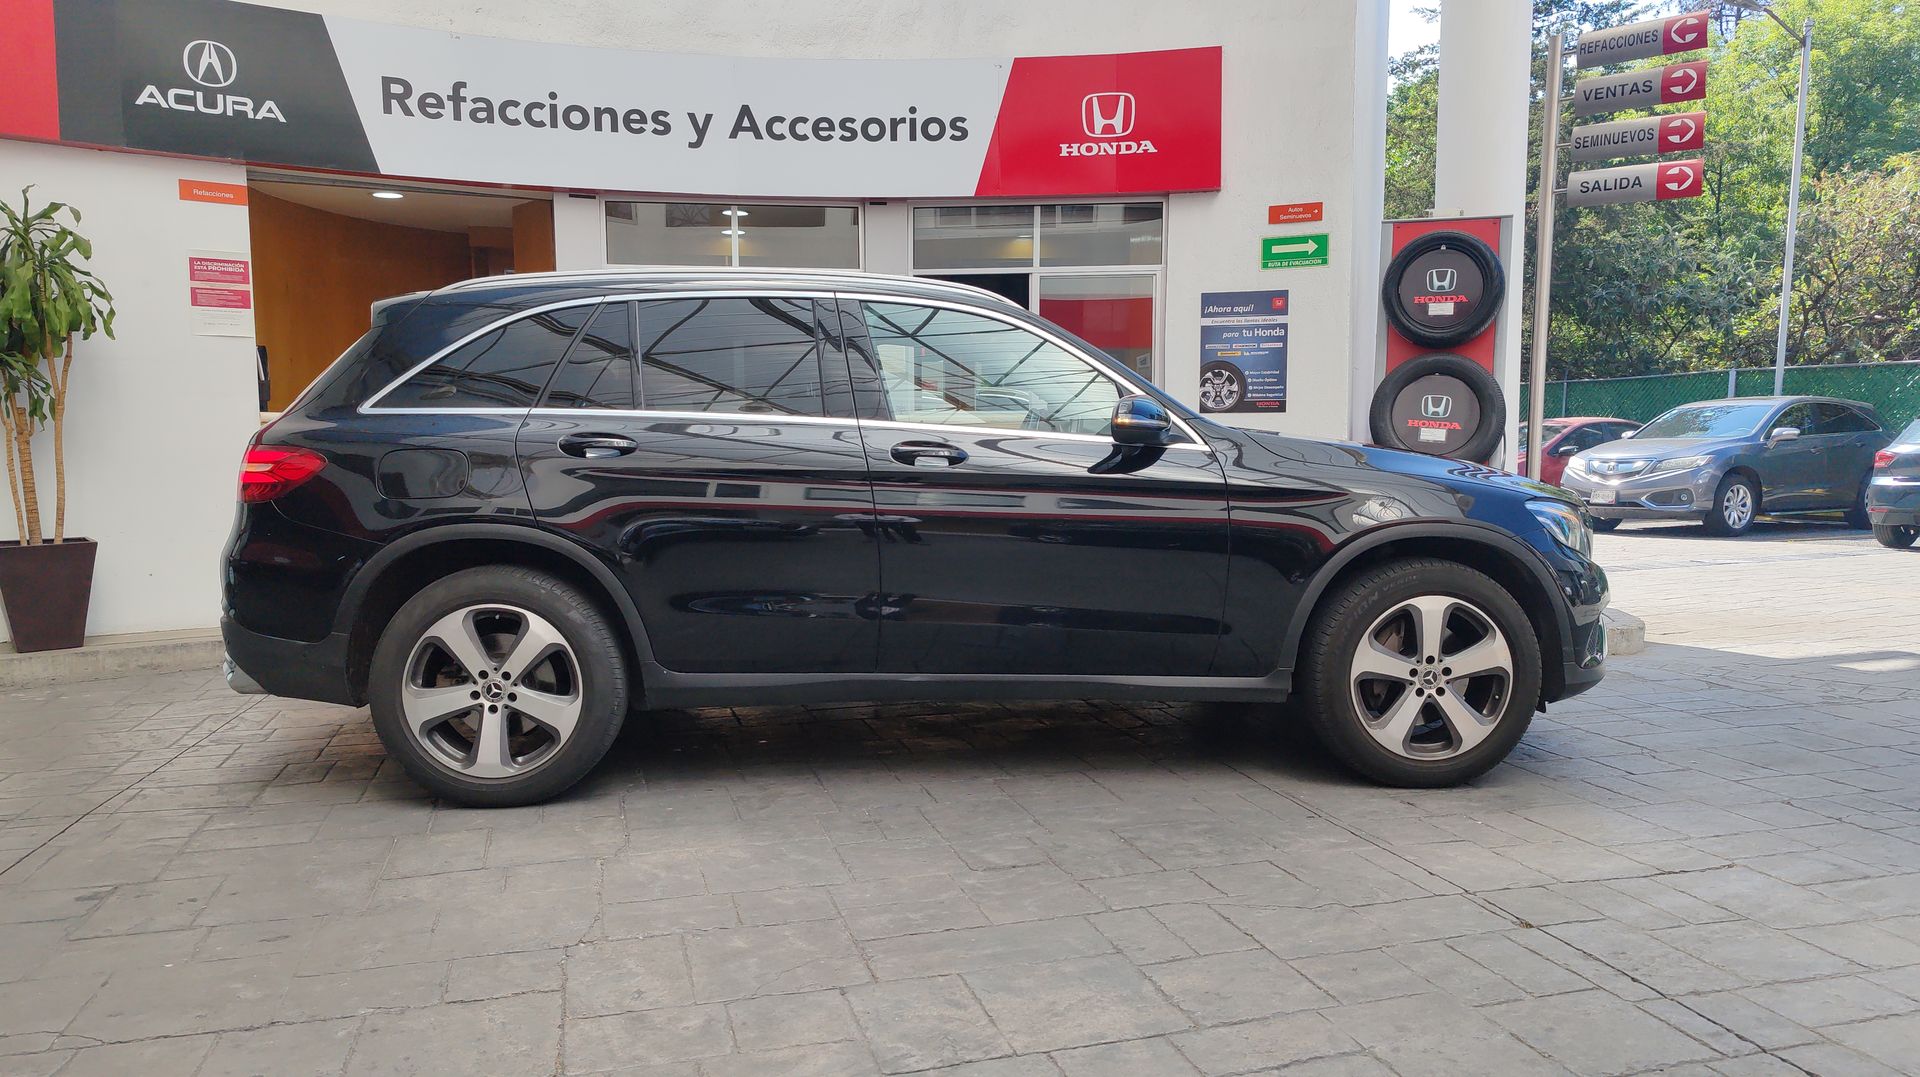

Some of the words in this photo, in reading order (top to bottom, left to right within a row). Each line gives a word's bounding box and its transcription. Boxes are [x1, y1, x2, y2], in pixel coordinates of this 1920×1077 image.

[1580, 29, 1659, 55] REFACCIONES
[1583, 80, 1653, 101] VENTAS
[135, 84, 287, 123] ACURA
[381, 75, 672, 136] Refacciones
[686, 112, 714, 149] y
[728, 104, 969, 142] Accesorios
[1574, 127, 1655, 149] SEMINUEVOS
[1059, 140, 1158, 157] HONDA
[192, 188, 234, 199] Refacciones
[1580, 176, 1642, 194] SALIDA
[1413, 295, 1468, 304] HONDA
[1204, 305, 1231, 313] ¡Ahora
[1233, 304, 1255, 314] aquí!
[1242, 329, 1253, 337] tu
[1254, 327, 1285, 337] Honda
[1407, 419, 1462, 430] HONDA
